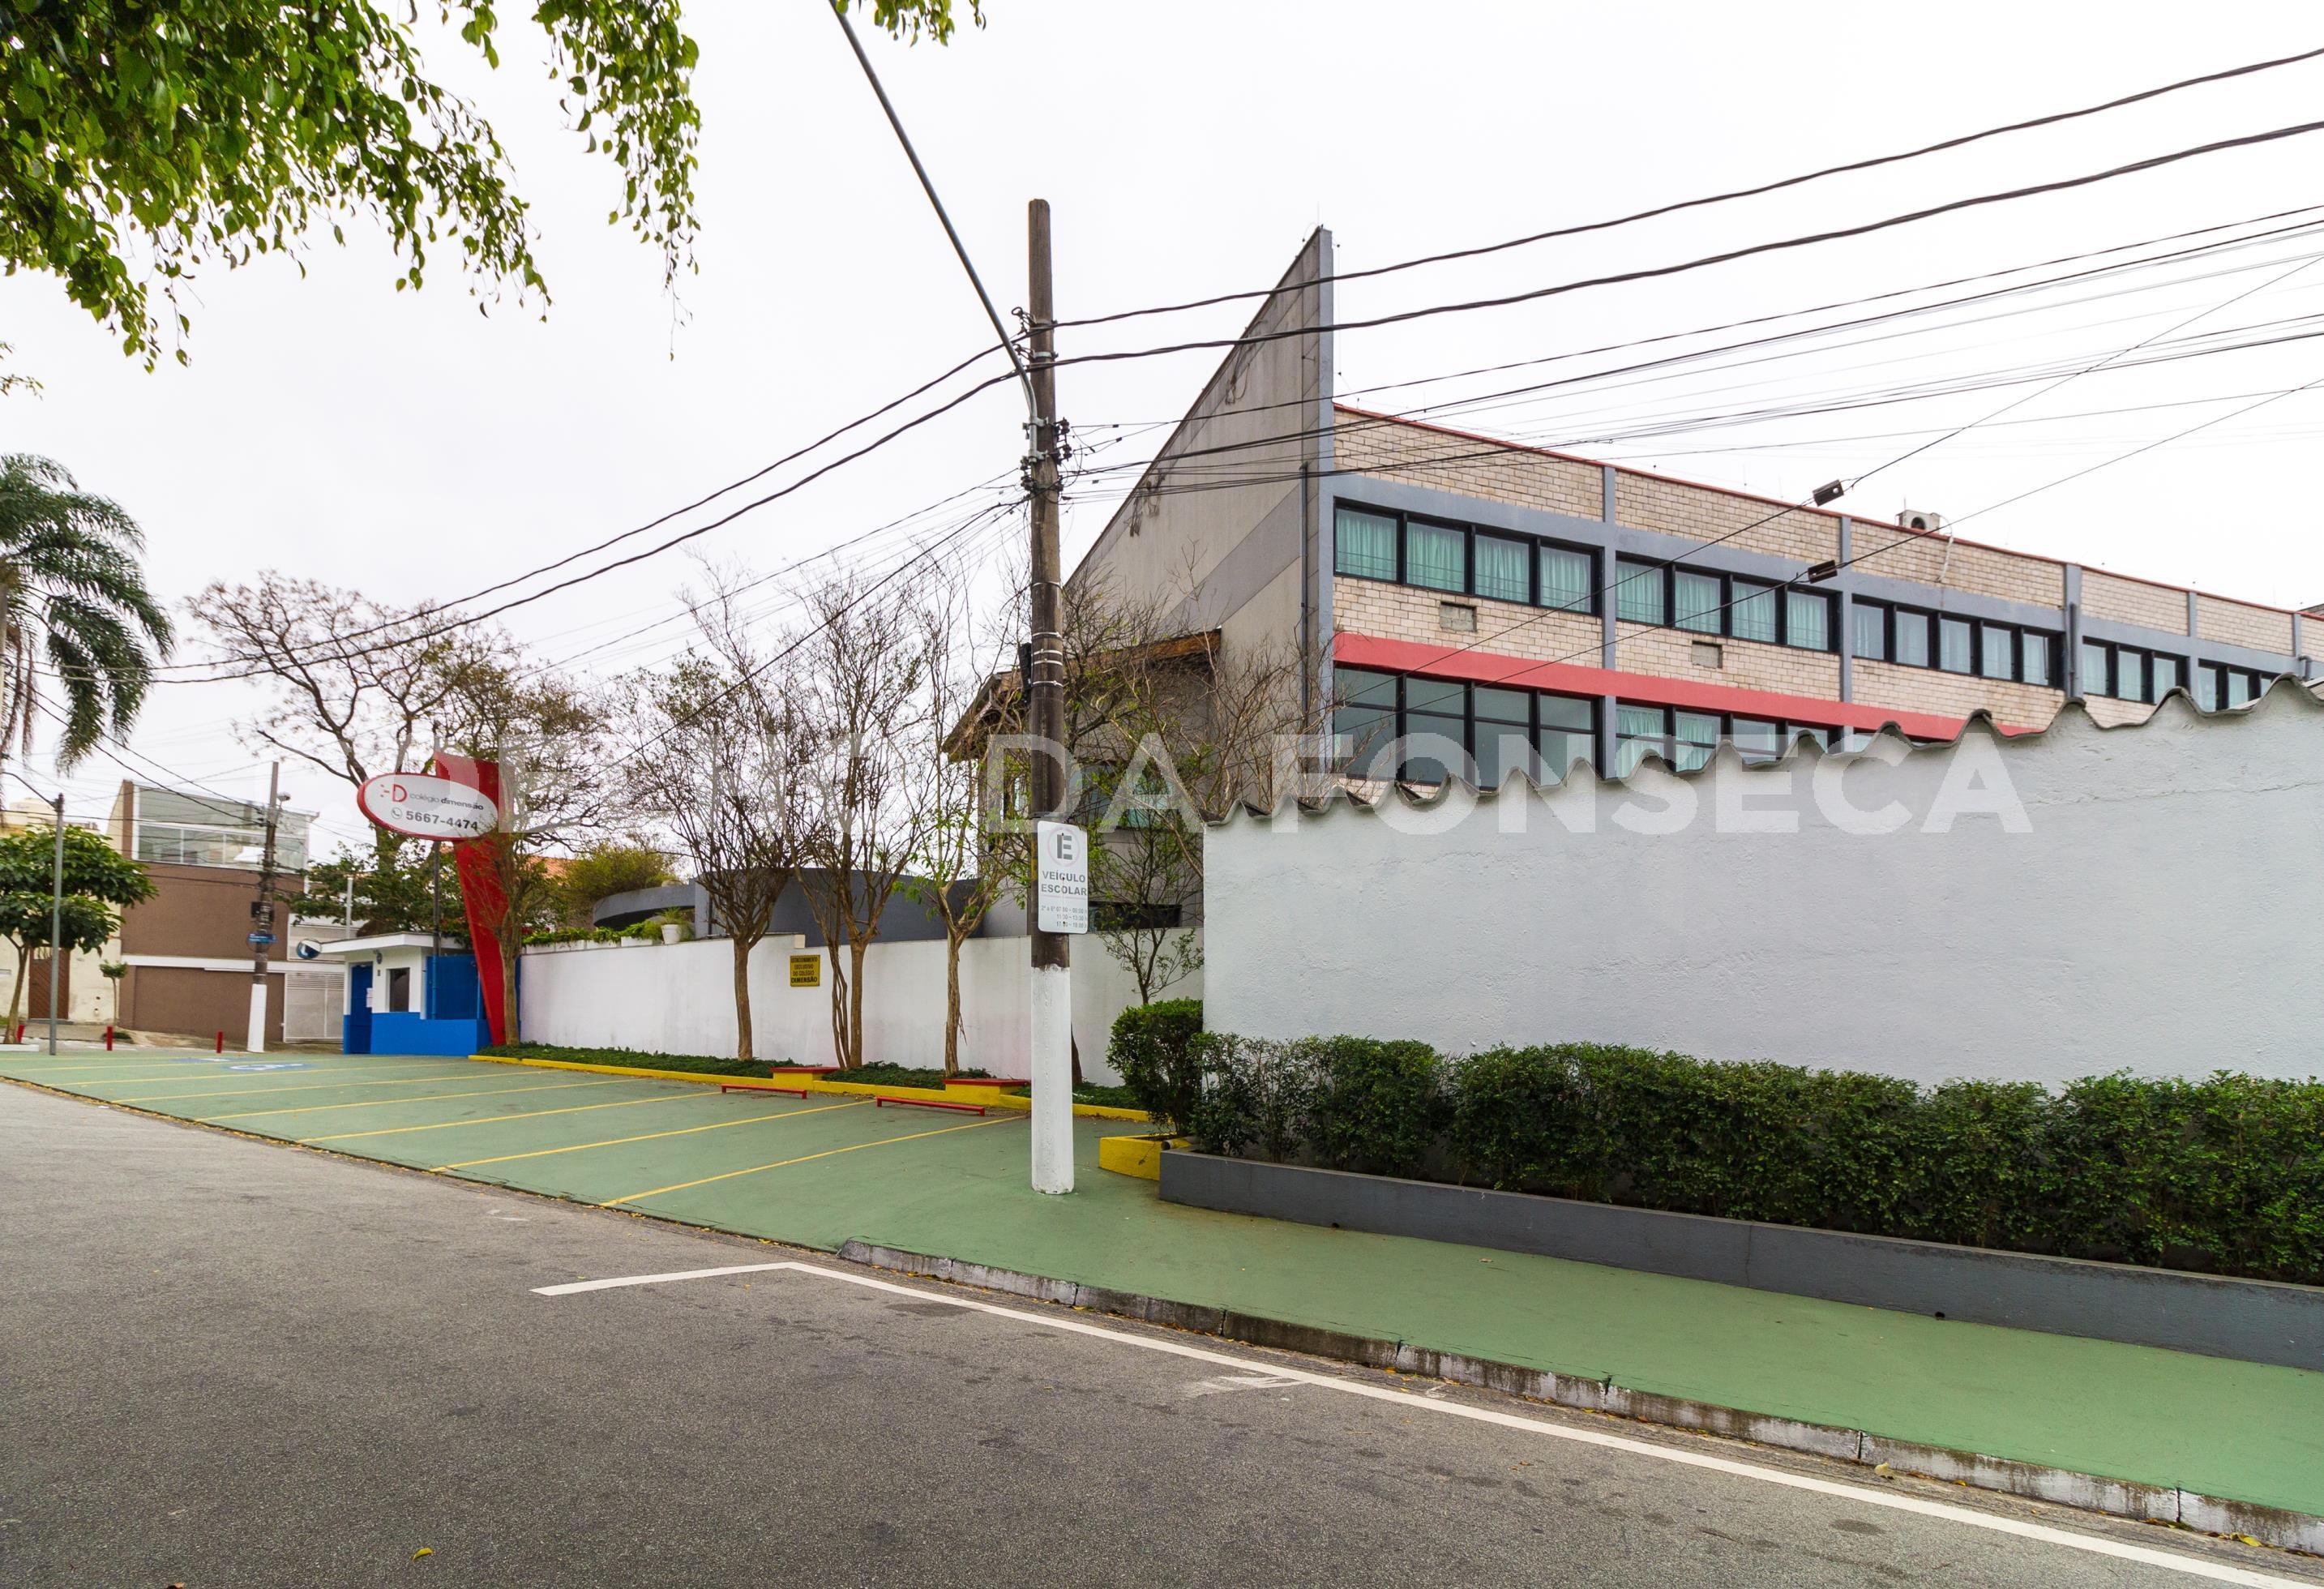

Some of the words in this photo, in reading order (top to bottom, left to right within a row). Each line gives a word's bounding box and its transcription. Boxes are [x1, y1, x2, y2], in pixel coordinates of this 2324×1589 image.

[440, 797, 484, 811] dimensão
[405, 810, 479, 832] 5667-4474
[1056, 833, 1072, 860] E
[1042, 870, 1086, 883] VEÍCULO
[1041, 884, 1087, 896] ESCOLAR
